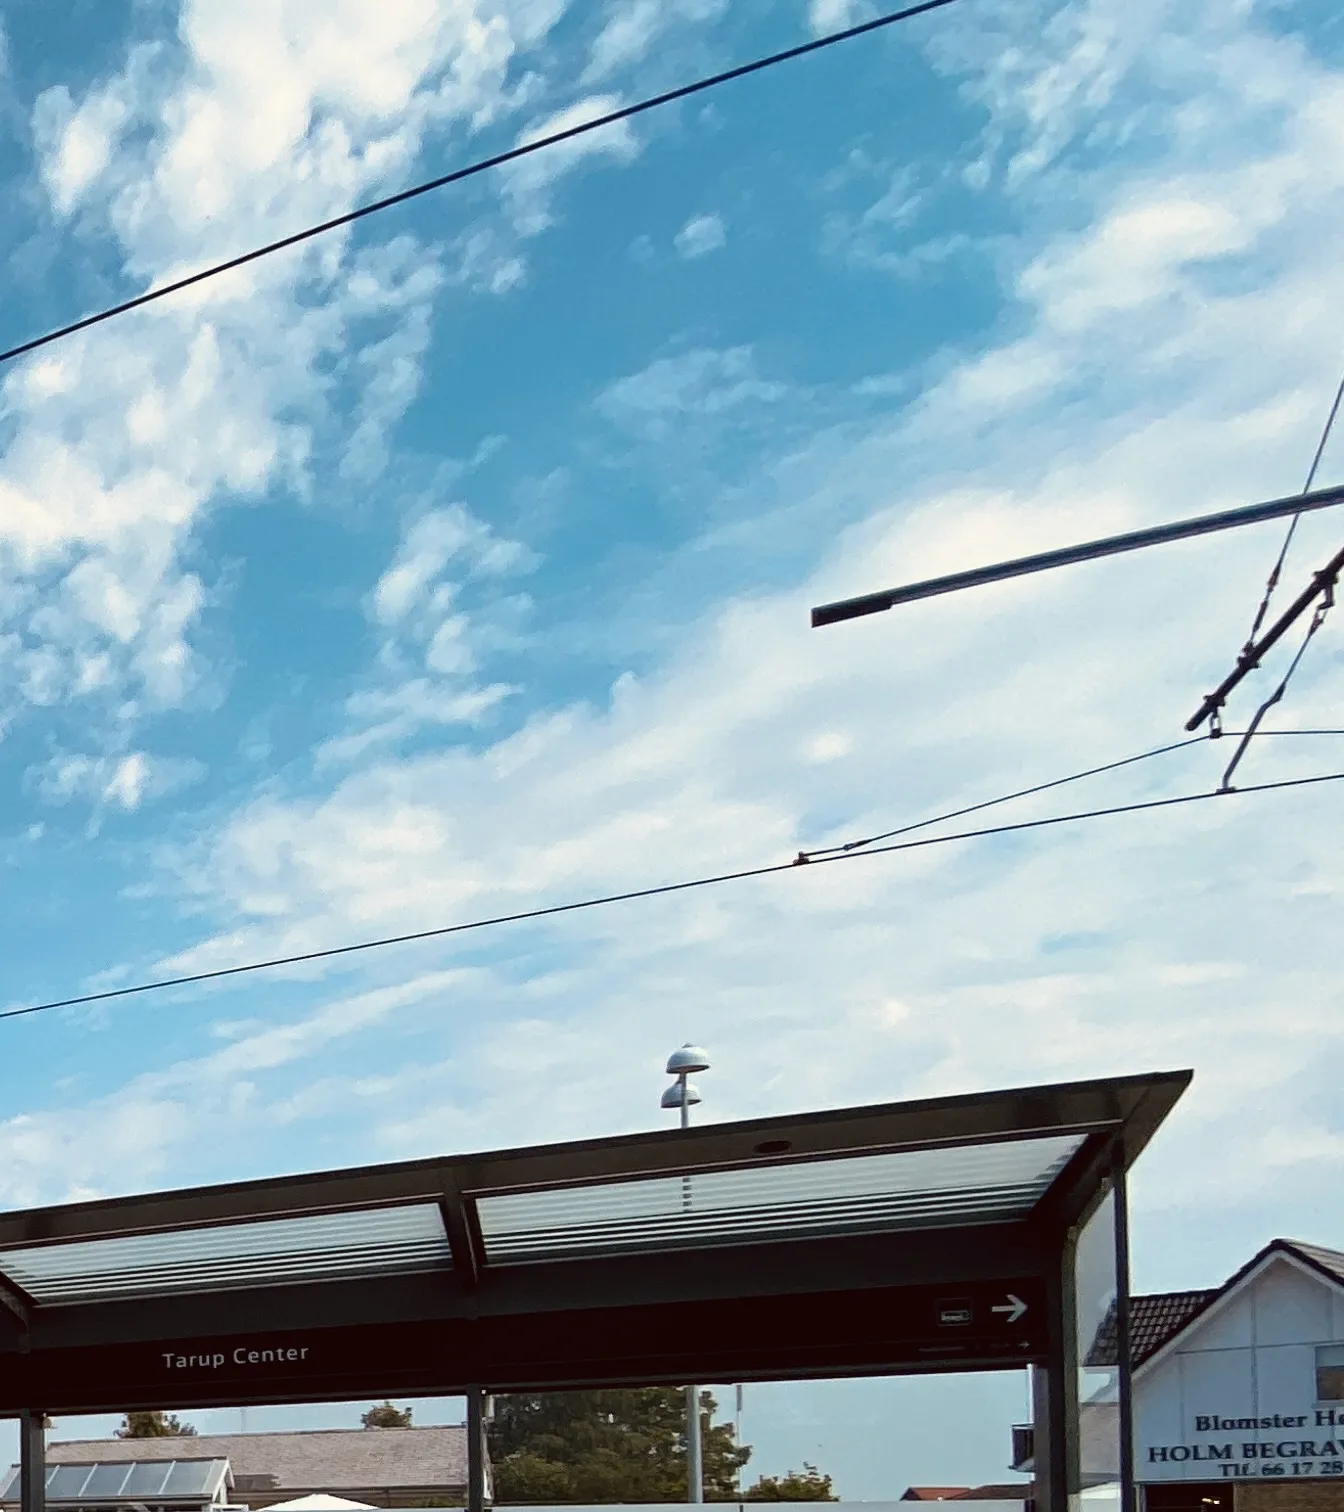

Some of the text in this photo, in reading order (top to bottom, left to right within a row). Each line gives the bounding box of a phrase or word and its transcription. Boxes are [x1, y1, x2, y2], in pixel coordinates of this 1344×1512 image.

[162, 1347, 309, 1368] Tarup Center
[1195, 1414, 1308, 1432] Blomster
[1147, 1444, 1233, 1463] HOLM
[1291, 1461, 1313, 1475] 17
